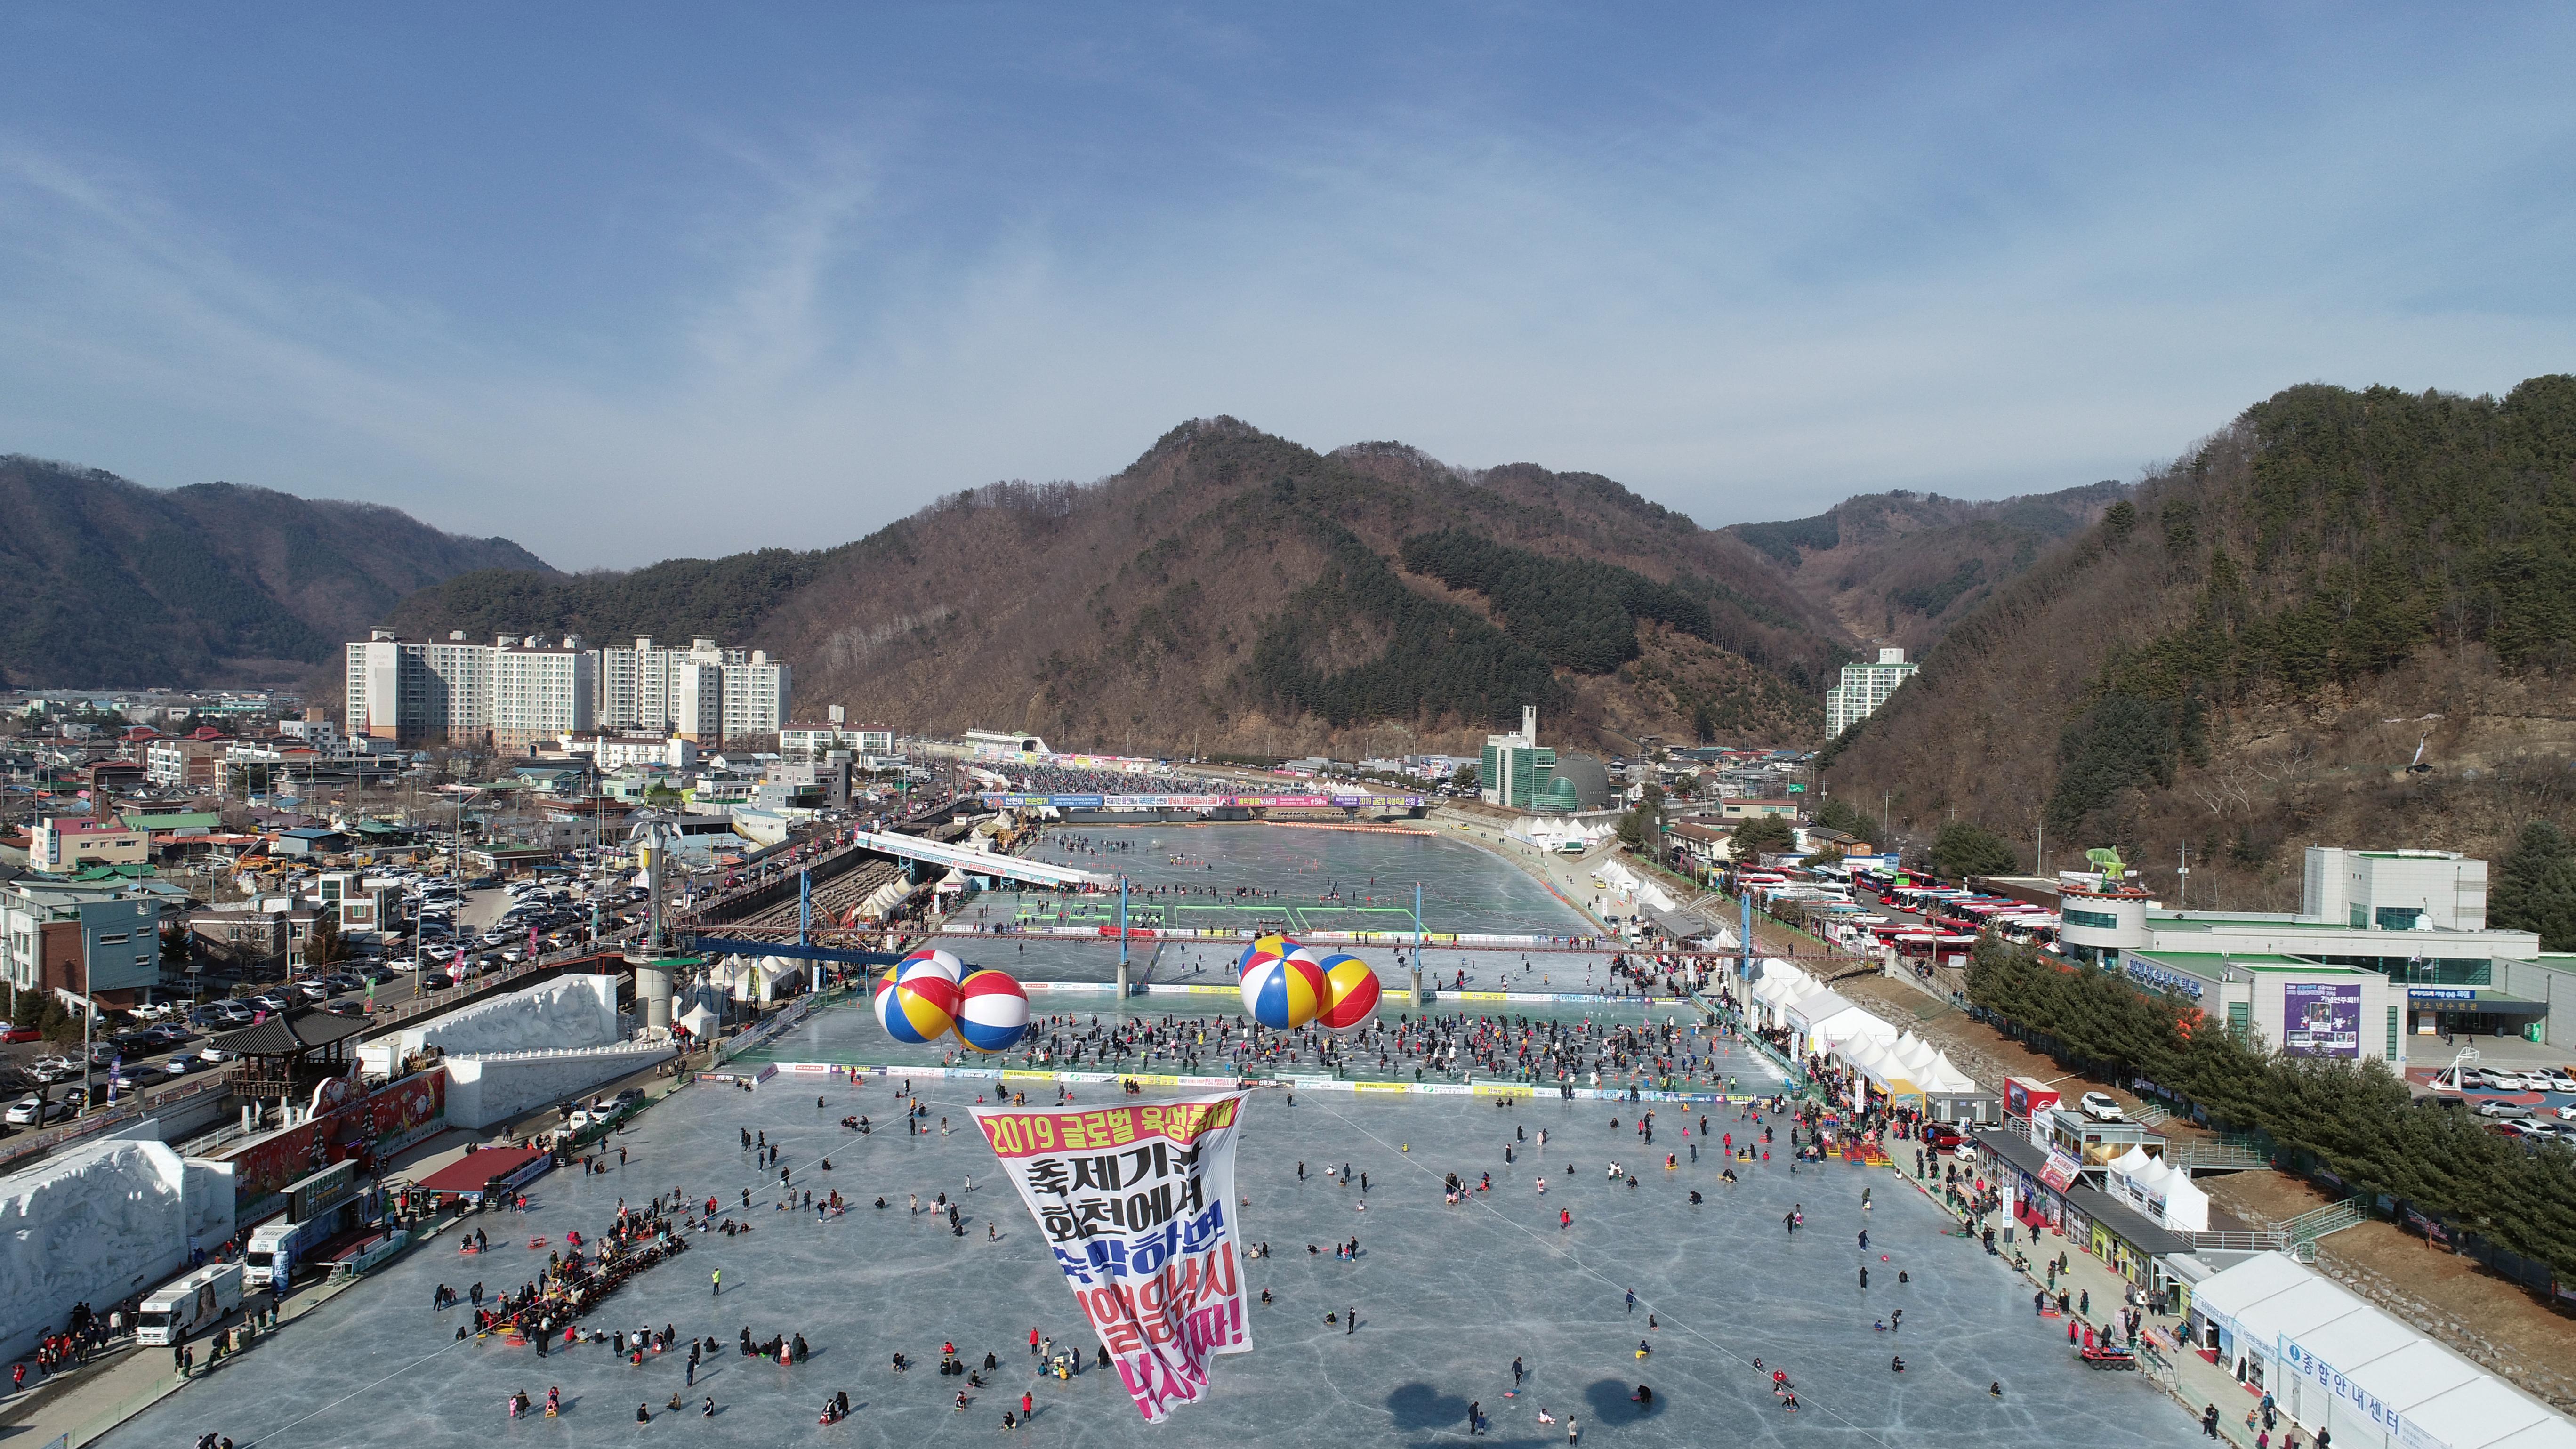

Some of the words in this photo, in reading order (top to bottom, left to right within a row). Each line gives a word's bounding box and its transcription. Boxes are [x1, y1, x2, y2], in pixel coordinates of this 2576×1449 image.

[1372, 797, 1385, 805] 글로벌
[1386, 797, 1405, 805] 육성축제
[1405, 797, 1415, 805] 선정
[905, 849, 921, 858] 화천에서
[922, 853, 940, 862] 숙박하면
[983, 1115, 1055, 1154] 2019
[1059, 1106, 1135, 1148] 글로벌
[1141, 1097, 1232, 1142] 육성축제
[1026, 1141, 1203, 1198] 축제기간
[1040, 1173, 1204, 1243] 화천에서
[2303, 1352, 2400, 1436] 종합안내센터
